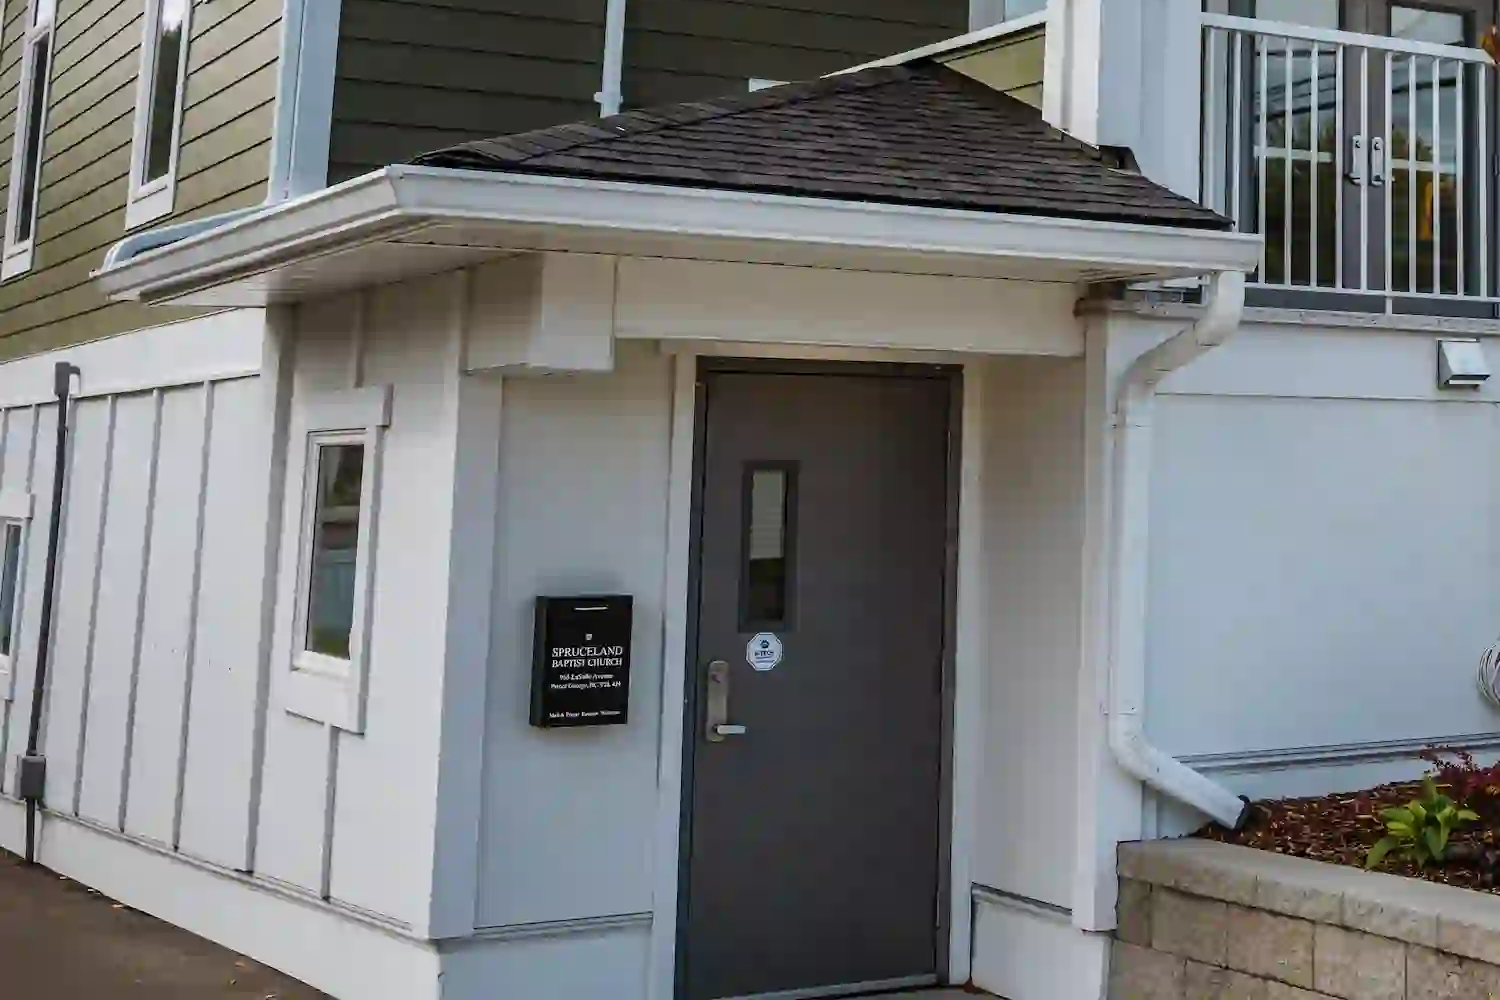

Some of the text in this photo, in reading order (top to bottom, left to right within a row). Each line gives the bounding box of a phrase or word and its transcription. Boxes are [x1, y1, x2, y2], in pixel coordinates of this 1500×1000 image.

[551, 646, 623, 657] SPRUCELAND
[551, 657, 622, 668] BAPTIST CHURCH
